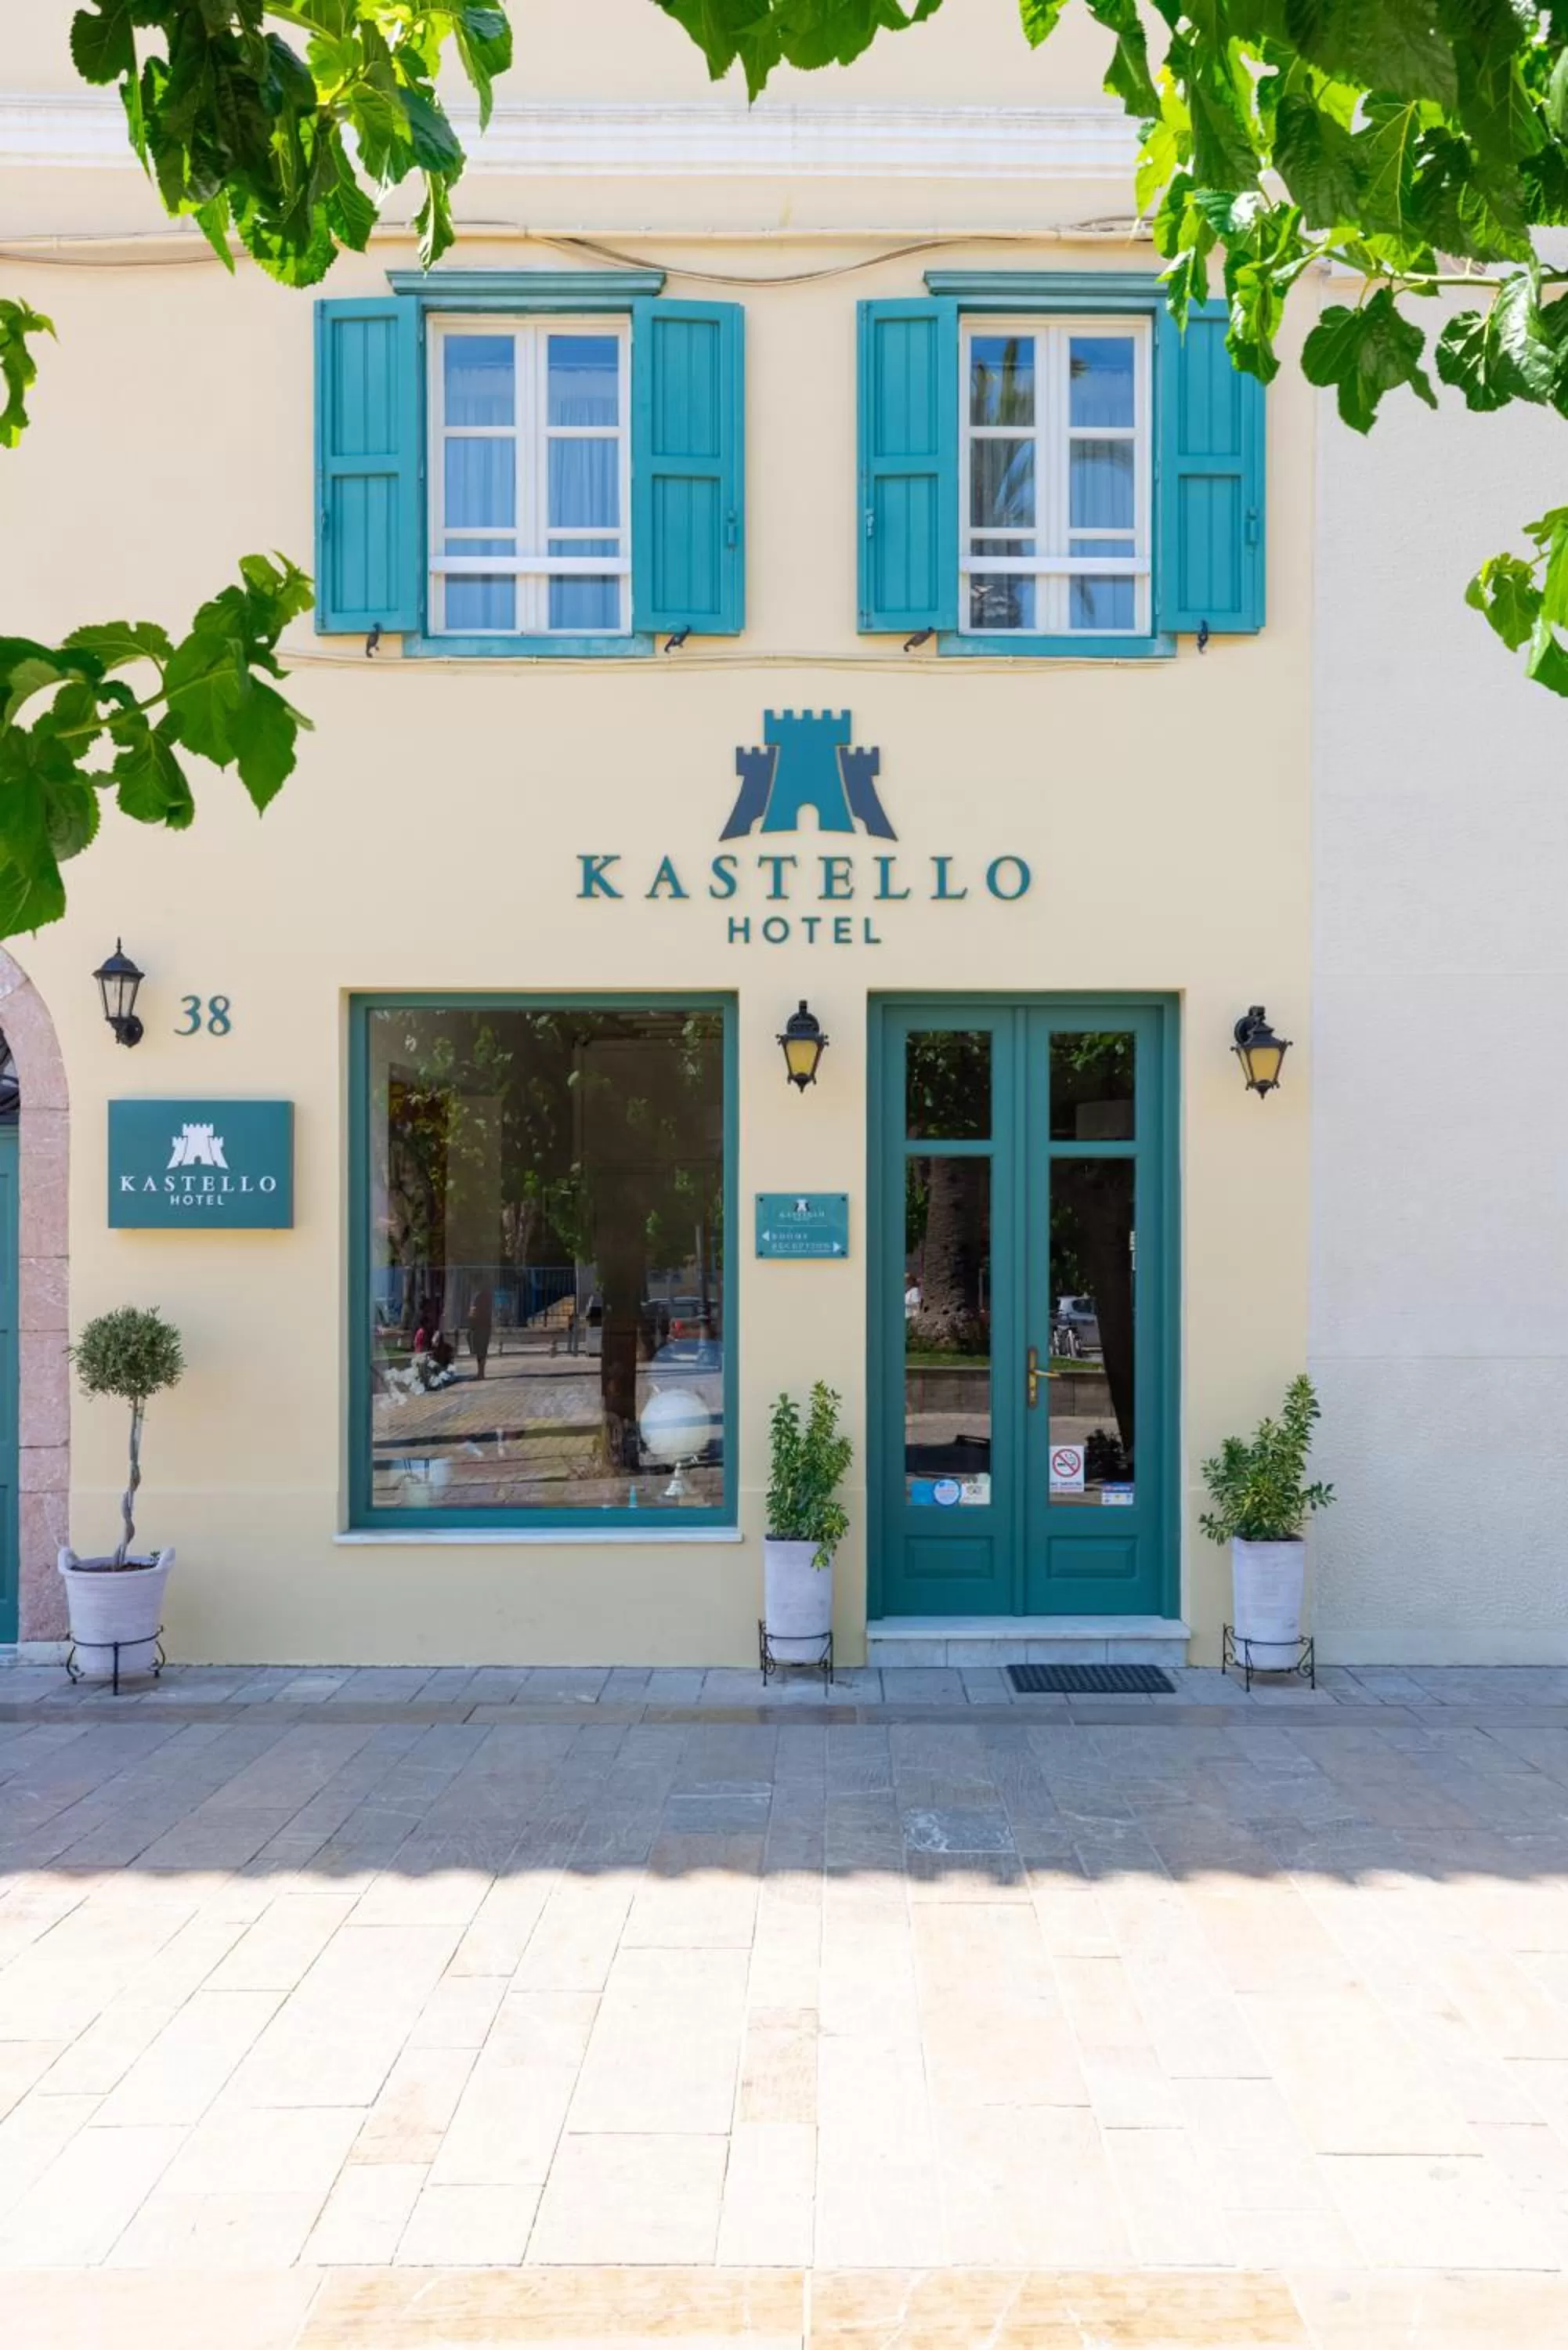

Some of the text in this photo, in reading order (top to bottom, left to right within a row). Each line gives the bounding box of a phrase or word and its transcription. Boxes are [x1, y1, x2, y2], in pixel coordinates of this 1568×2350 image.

[576, 855, 1031, 900] KASTELLO
[728, 916, 882, 944] HOTEL
[174, 995, 232, 1036] 38
[120, 1176, 276, 1191] KASTELLO
[170, 1195, 225, 1206] HOTEL
